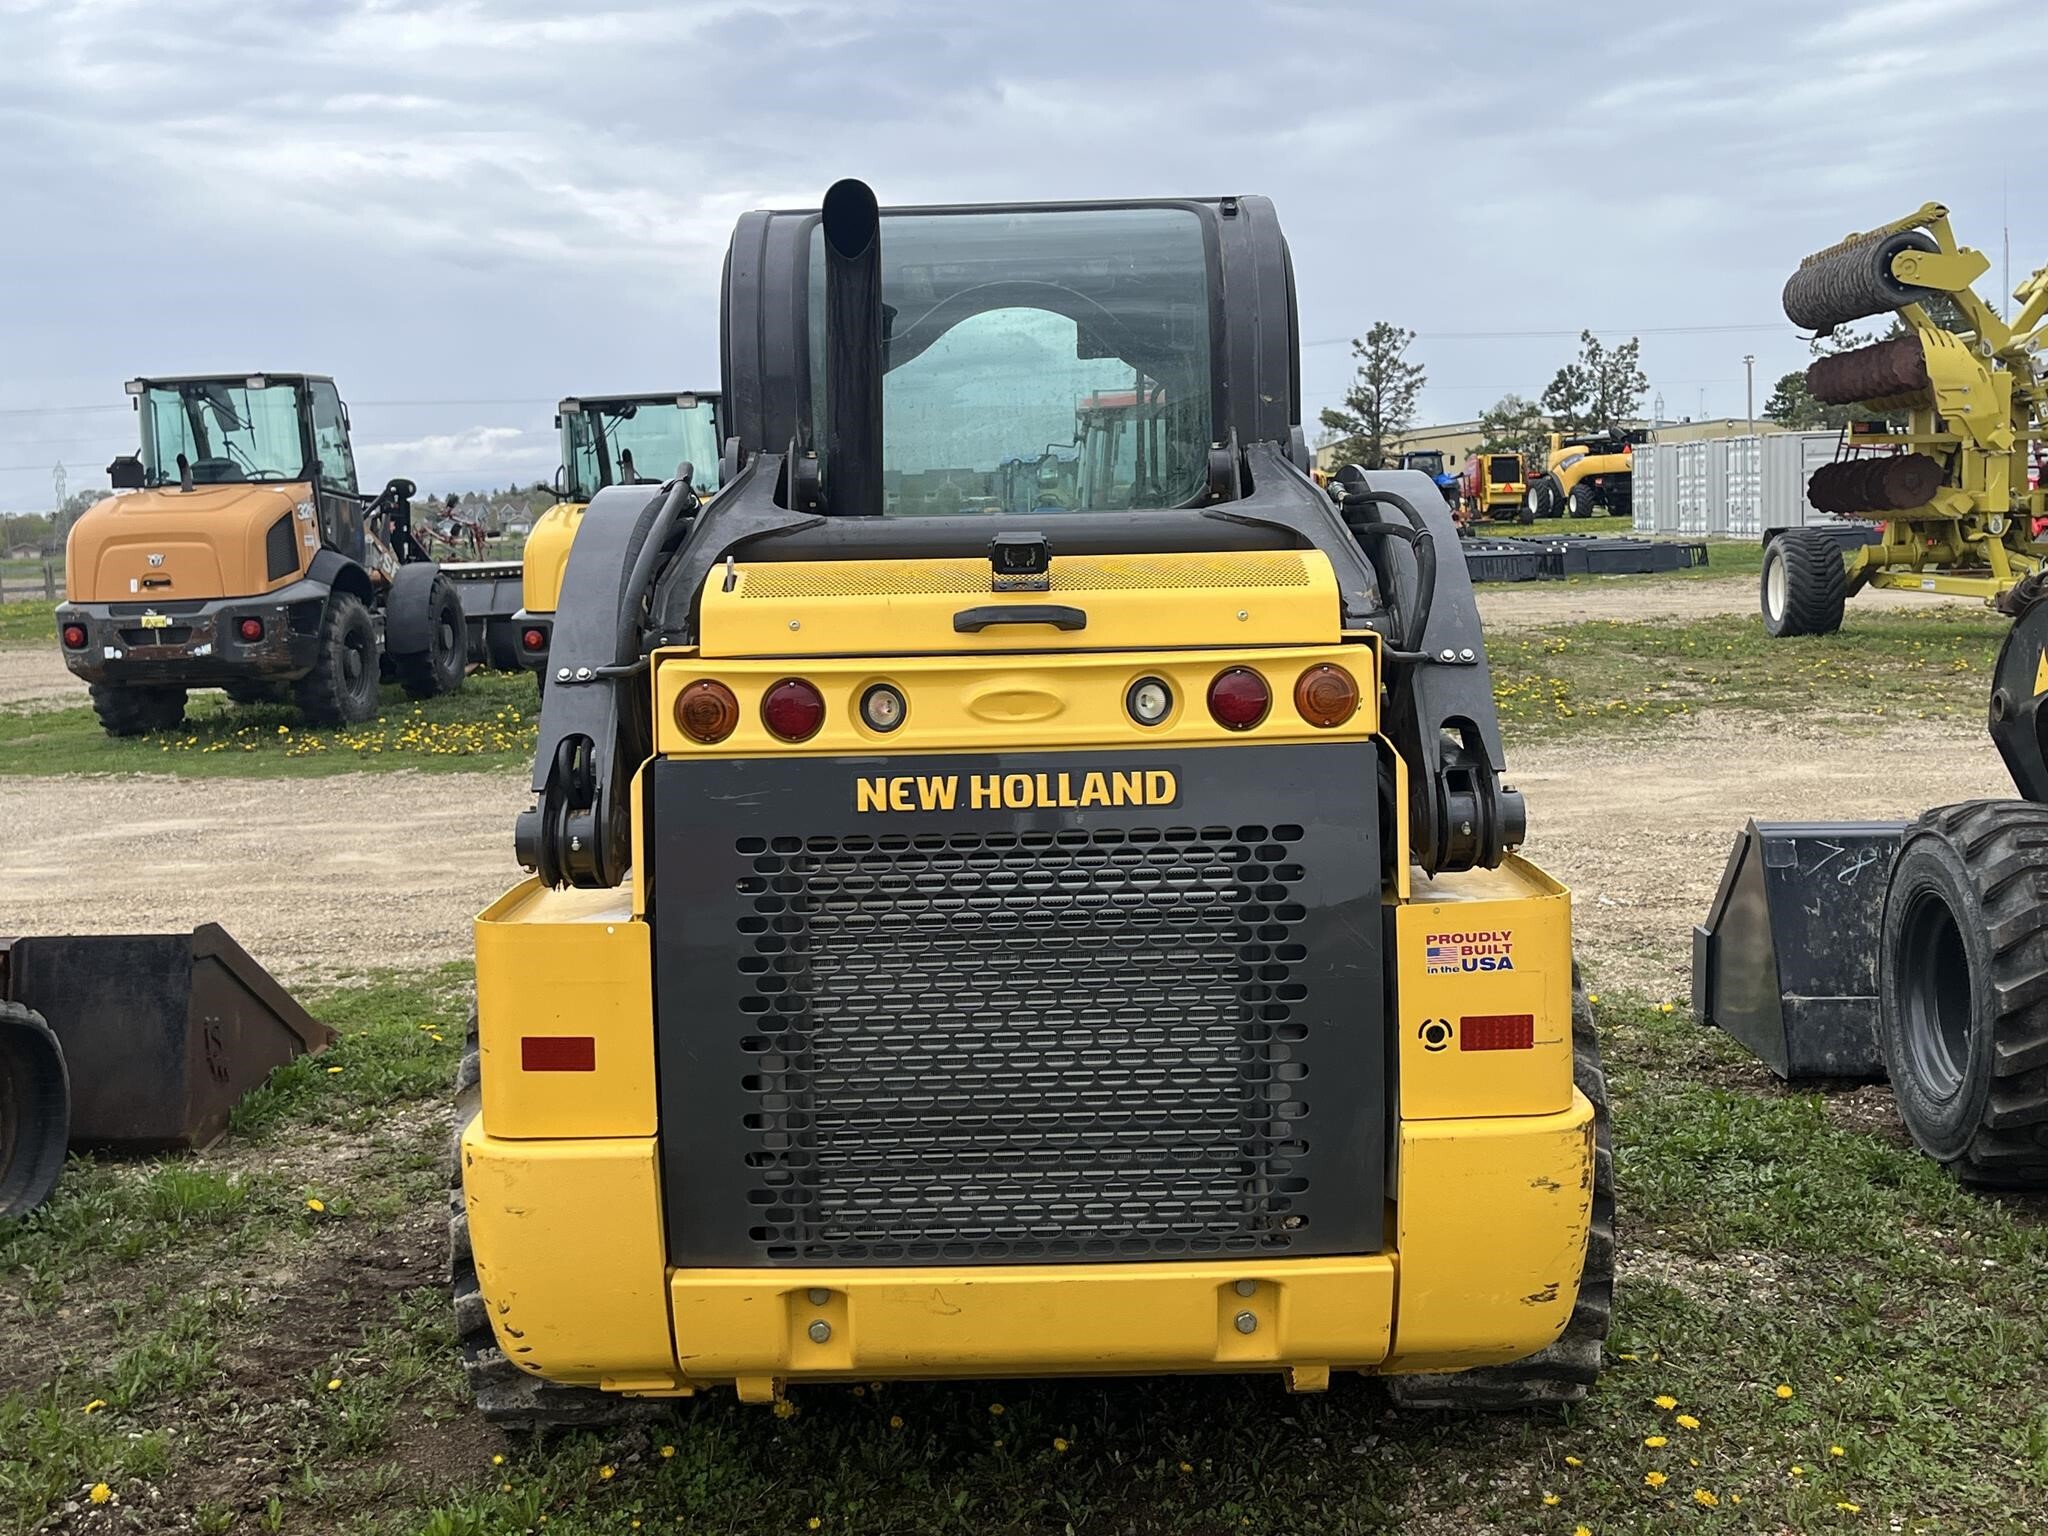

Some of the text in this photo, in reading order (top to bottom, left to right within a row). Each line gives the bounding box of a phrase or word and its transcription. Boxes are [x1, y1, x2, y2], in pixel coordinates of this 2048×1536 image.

[856, 770, 1177, 812] NEW HOLLAND
[1426, 931, 1512, 945] PROUDLY
[1461, 943, 1513, 956] BUILT
[1427, 966, 1438, 974] in
[1461, 956, 1514, 972] USA
